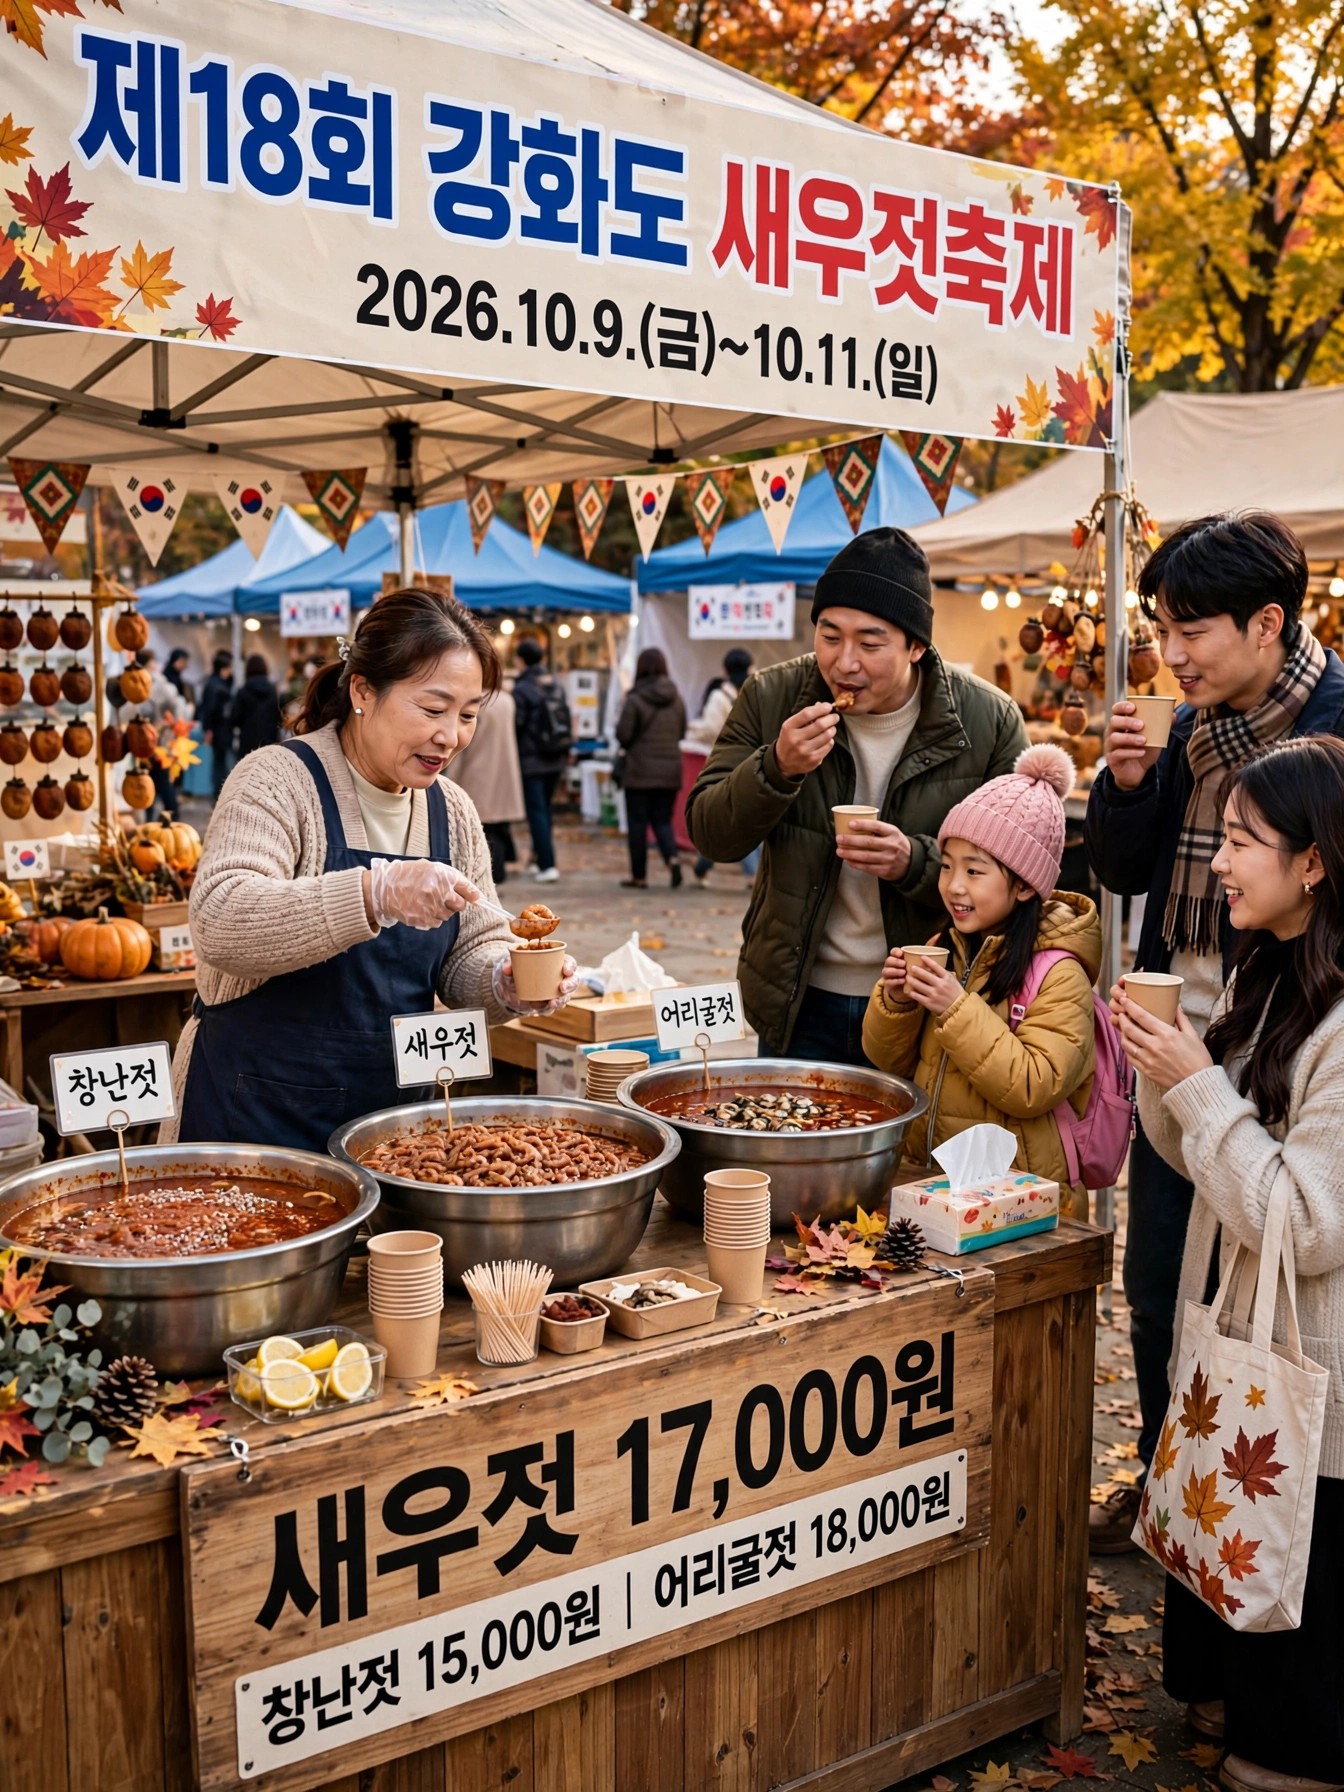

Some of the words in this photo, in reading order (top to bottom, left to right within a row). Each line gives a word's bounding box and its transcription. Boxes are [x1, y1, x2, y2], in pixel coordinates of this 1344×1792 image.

[78, 33, 394, 220] 제18회
[427, 100, 688, 267] 강화도
[711, 160, 1073, 335] 새우젓축제
[356, 263, 938, 405] 2026.10.9.(금)~10.11.(일)
[404, 1021, 478, 1061] 새우젓
[661, 992, 736, 1029] 어리굴젓
[68, 1058, 159, 1107] 창난젓
[254, 1429, 580, 1632] 새우젓
[616, 1331, 956, 1526] 17,000원
[261, 1647, 402, 1746] 창난젓
[417, 1584, 601, 1691] 15,000원
[654, 1520, 798, 1610] 어리굴젓
[809, 1470, 952, 1559] 18,000원
